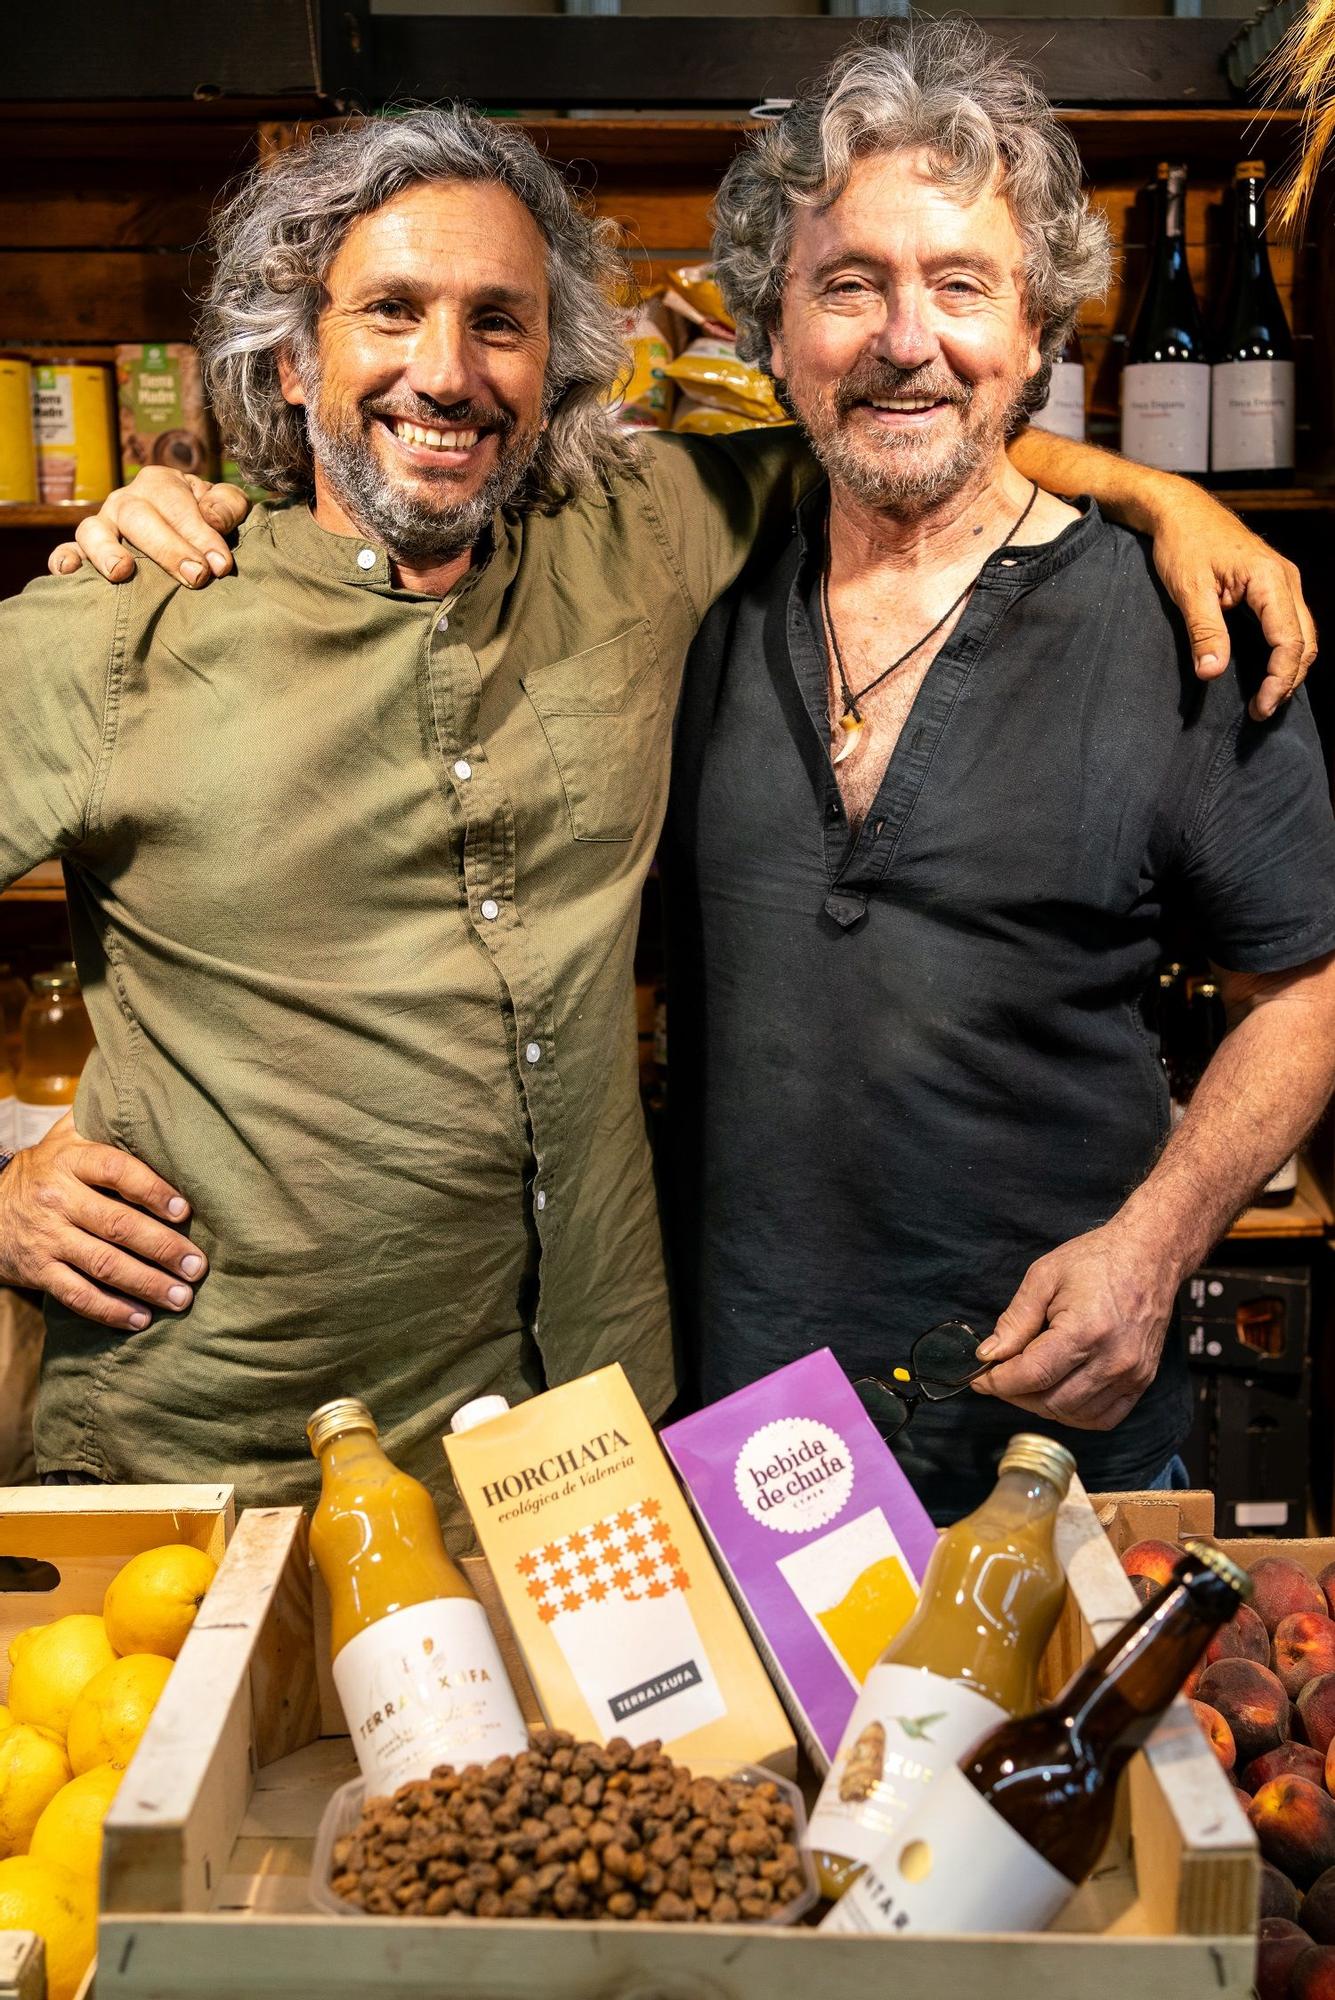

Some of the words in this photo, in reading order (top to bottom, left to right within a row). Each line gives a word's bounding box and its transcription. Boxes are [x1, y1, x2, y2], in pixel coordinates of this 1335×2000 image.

[481, 1428, 631, 1507] HORCHATA
[498, 1491, 560, 1523] ecológica
[562, 1479, 577, 1498] de
[579, 1454, 635, 1488] Valencia
[749, 1438, 827, 1488] bebida
[756, 1488, 786, 1512] de
[786, 1456, 846, 1497] chufa
